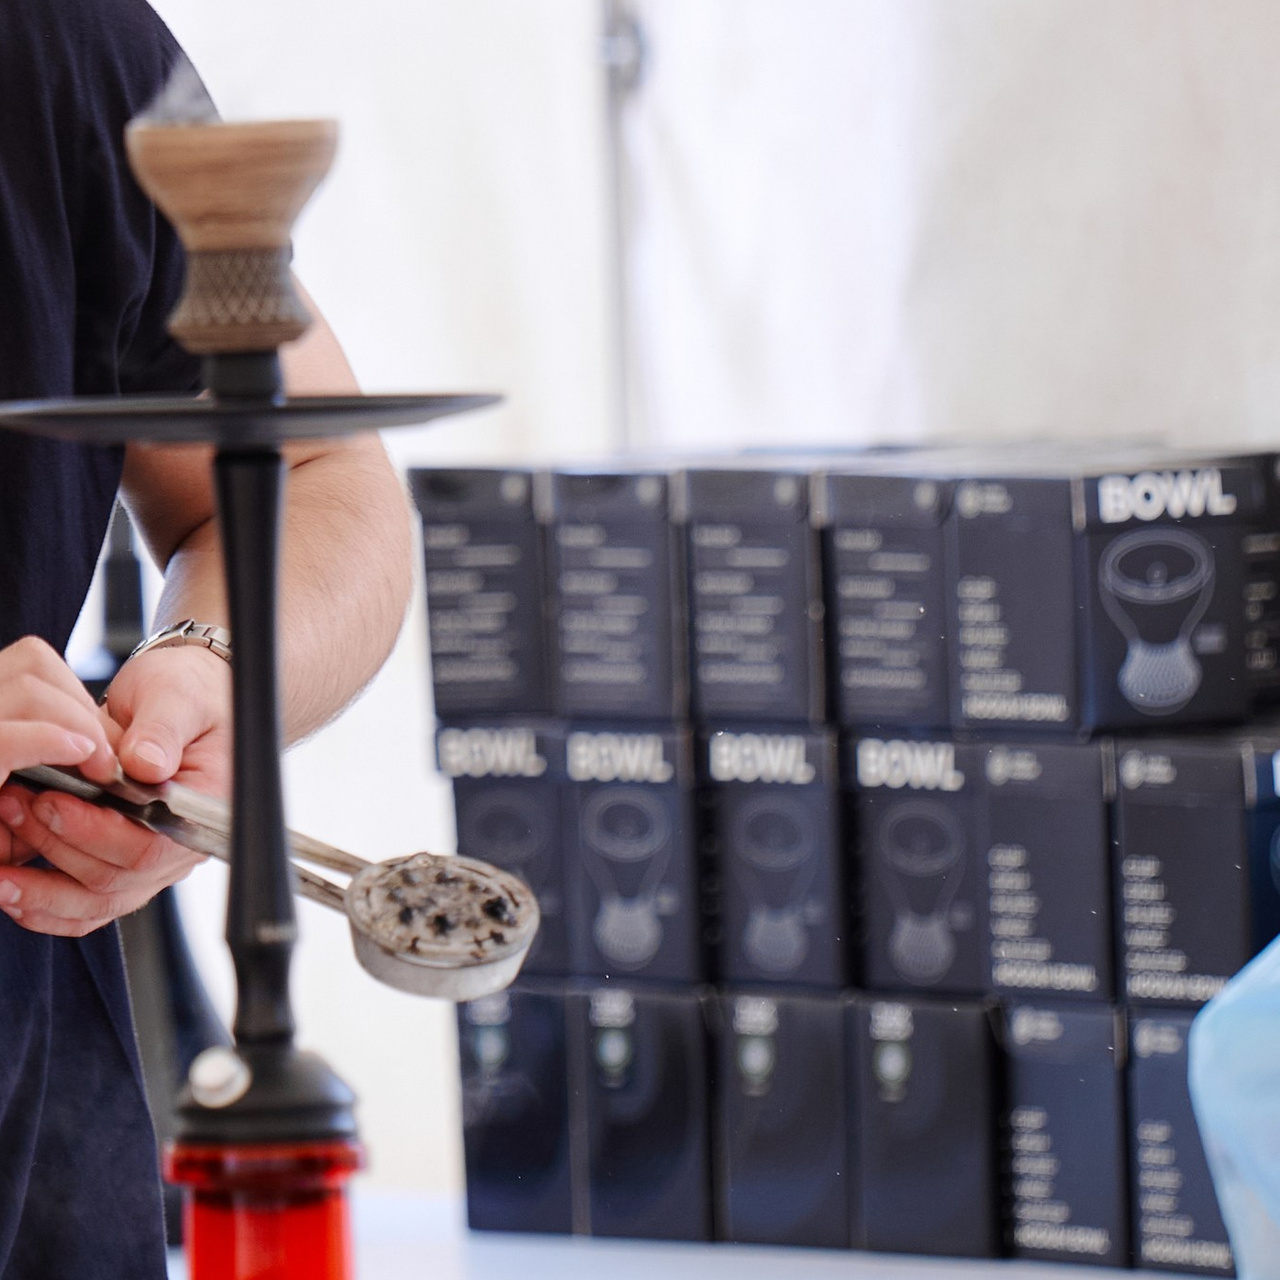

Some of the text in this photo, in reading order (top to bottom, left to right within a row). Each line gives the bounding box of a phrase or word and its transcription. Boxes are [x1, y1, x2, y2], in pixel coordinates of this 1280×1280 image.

[1097, 468, 1237, 524] BOWL
[438, 728, 548, 778] BOWL
[567, 731, 675, 783] BOWL
[709, 732, 817, 785] BOWL
[857, 738, 966, 792] BOWL
